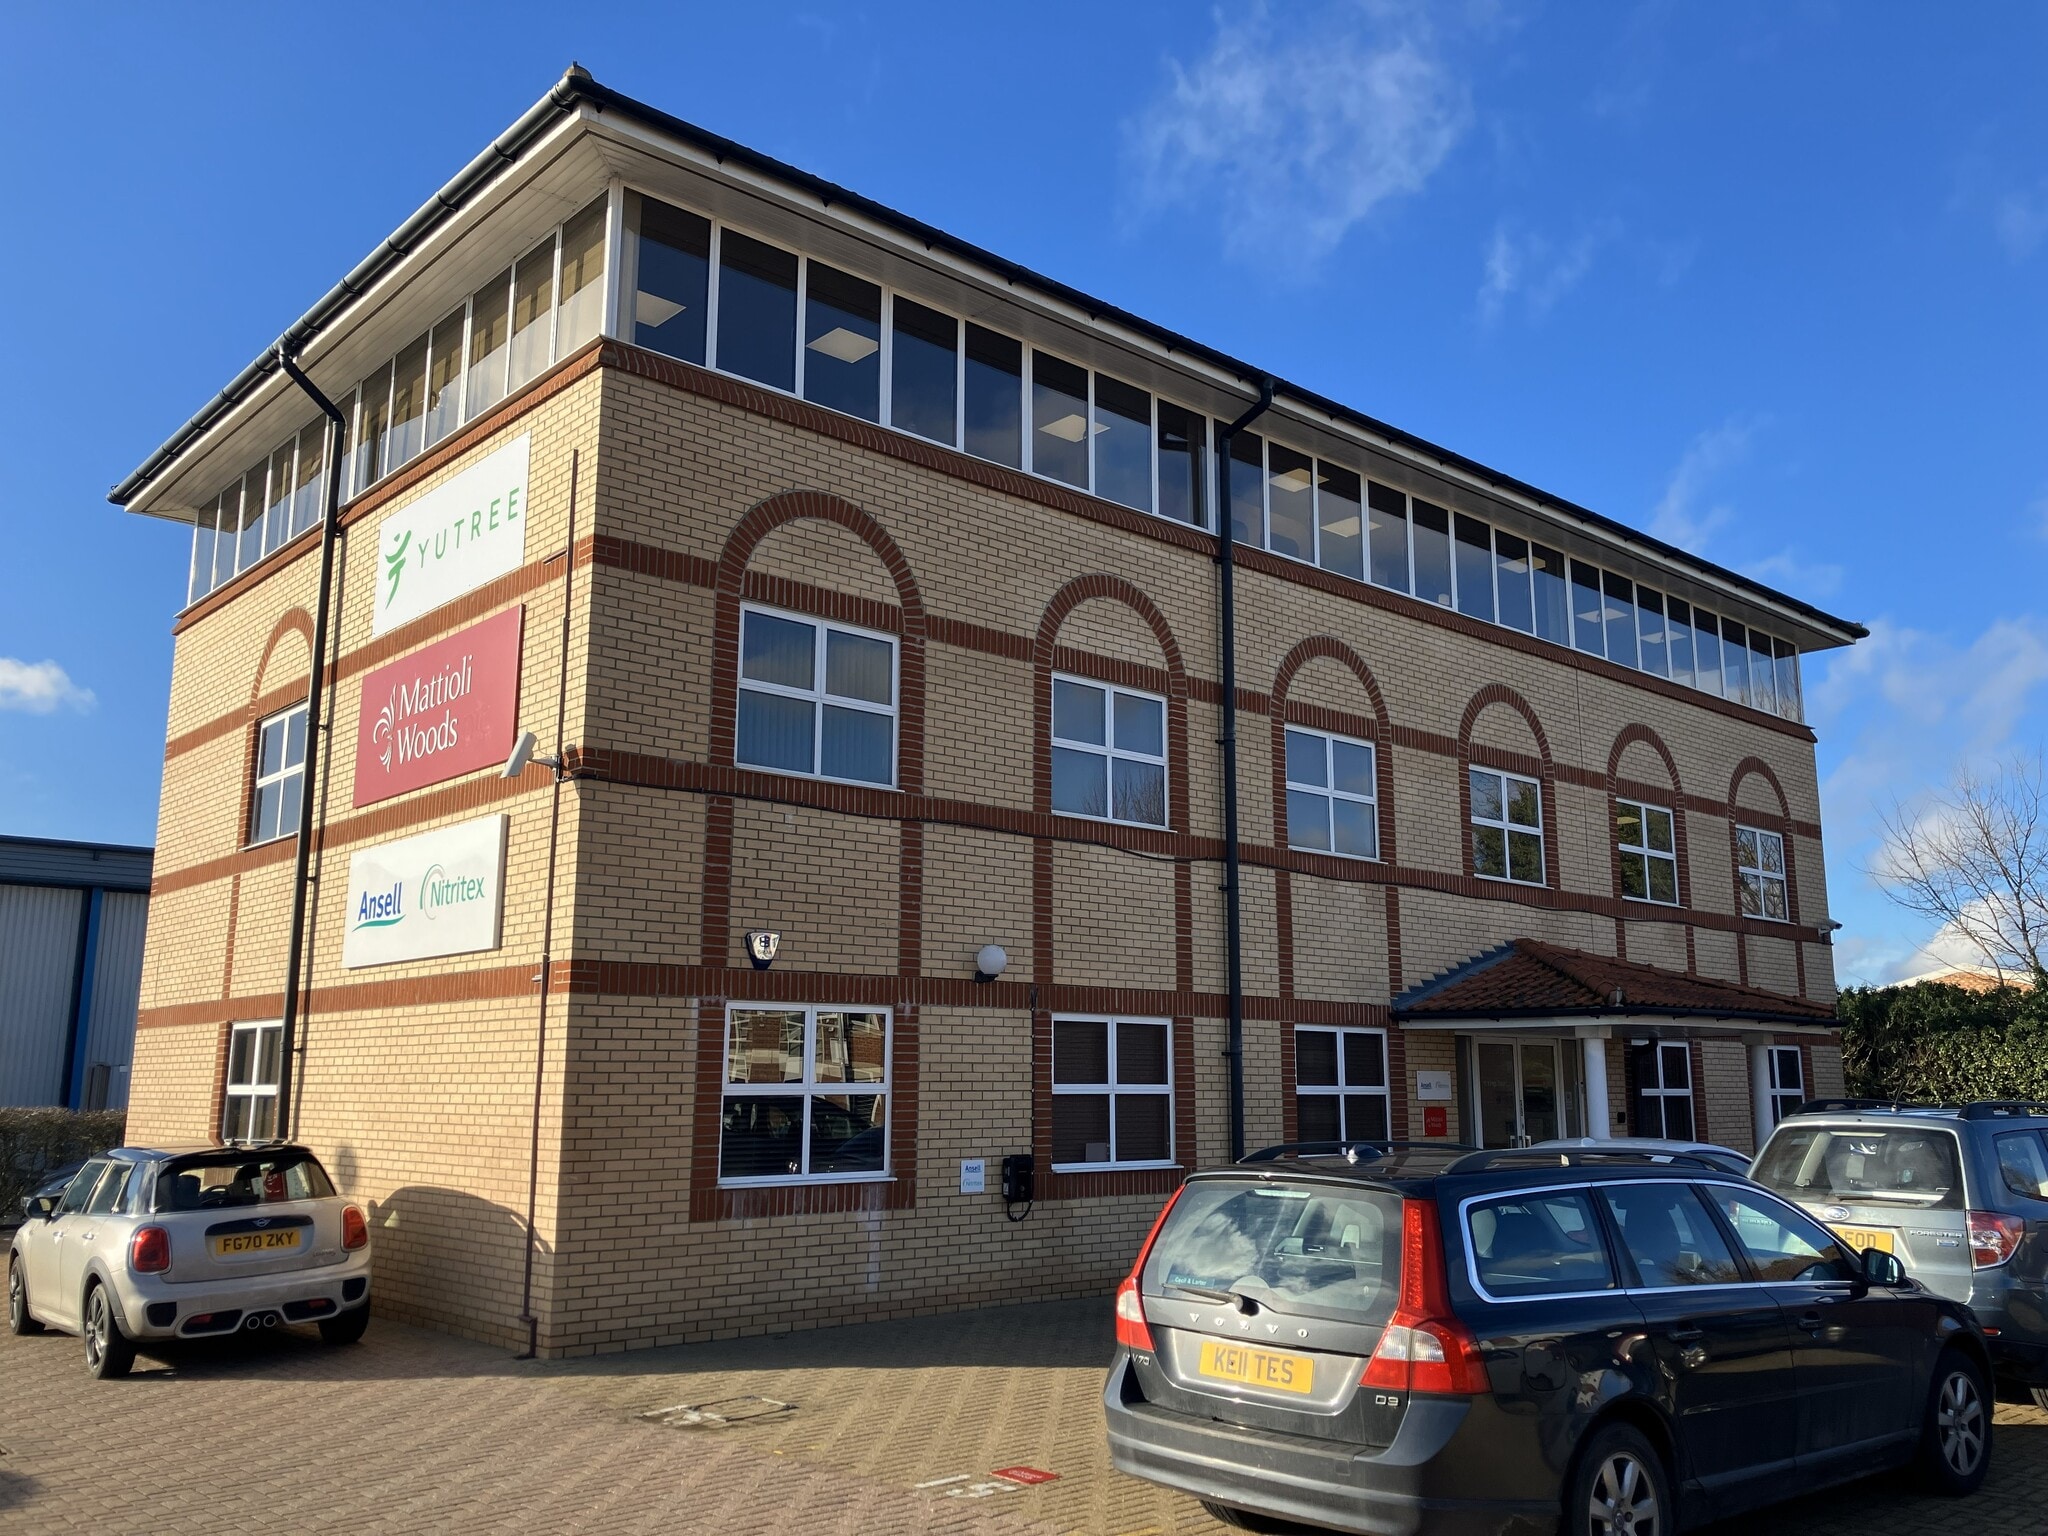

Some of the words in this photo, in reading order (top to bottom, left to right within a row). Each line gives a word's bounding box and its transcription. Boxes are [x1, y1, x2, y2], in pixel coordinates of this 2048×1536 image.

[418, 487, 519, 569] YUTREE
[399, 655, 473, 720] Mattioli
[397, 709, 458, 765] Woods
[358, 881, 402, 922] Ansell
[430, 876, 485, 908] Nitritex
[223, 1234, 262, 1252] FG70
[266, 1231, 294, 1247] ZKY
[1910, 1229, 1963, 1238] FORESTER
[1190, 1312, 1308, 1338] VOLVO
[1254, 1354, 1294, 1384] TES
